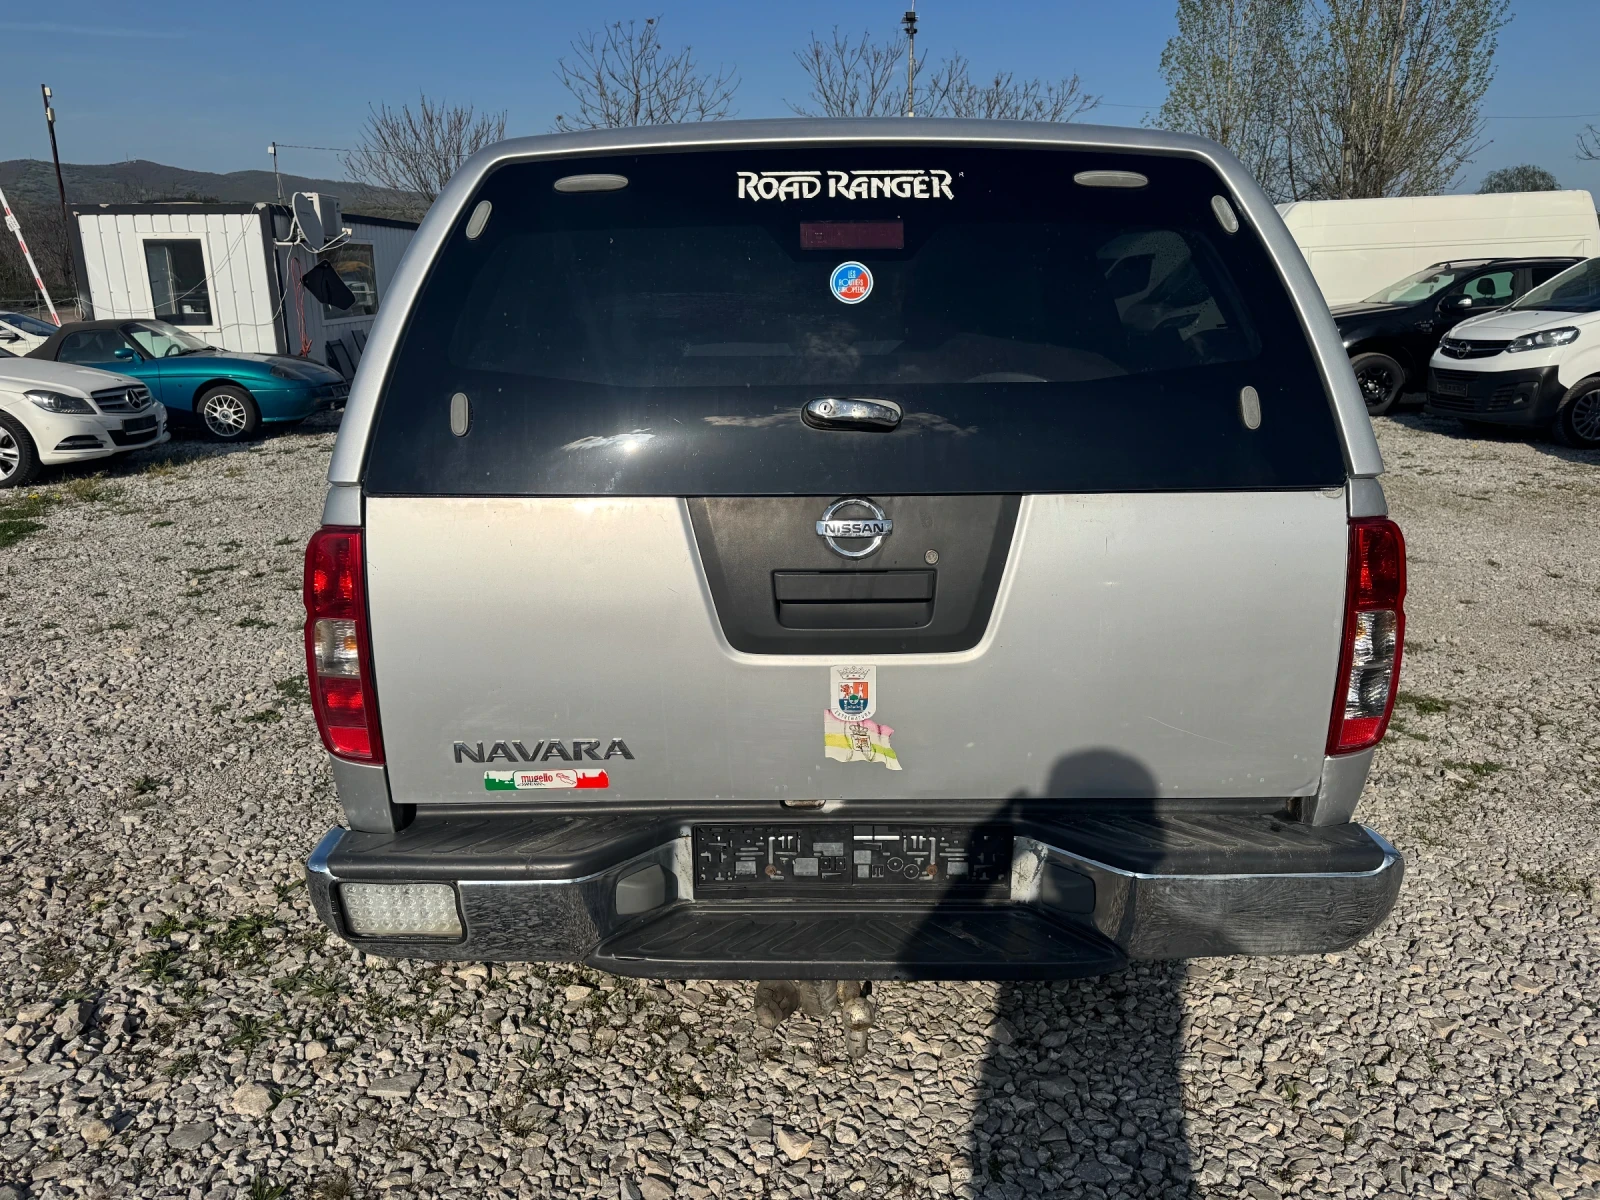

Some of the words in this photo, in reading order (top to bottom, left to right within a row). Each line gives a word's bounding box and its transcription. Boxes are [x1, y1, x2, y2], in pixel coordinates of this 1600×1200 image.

[736, 171, 822, 202] ROAD
[826, 169, 955, 201] RANGER
[824, 522, 884, 534] NISSAN
[453, 737, 636, 763] NAVARA
[520, 773, 554, 783] mugello
